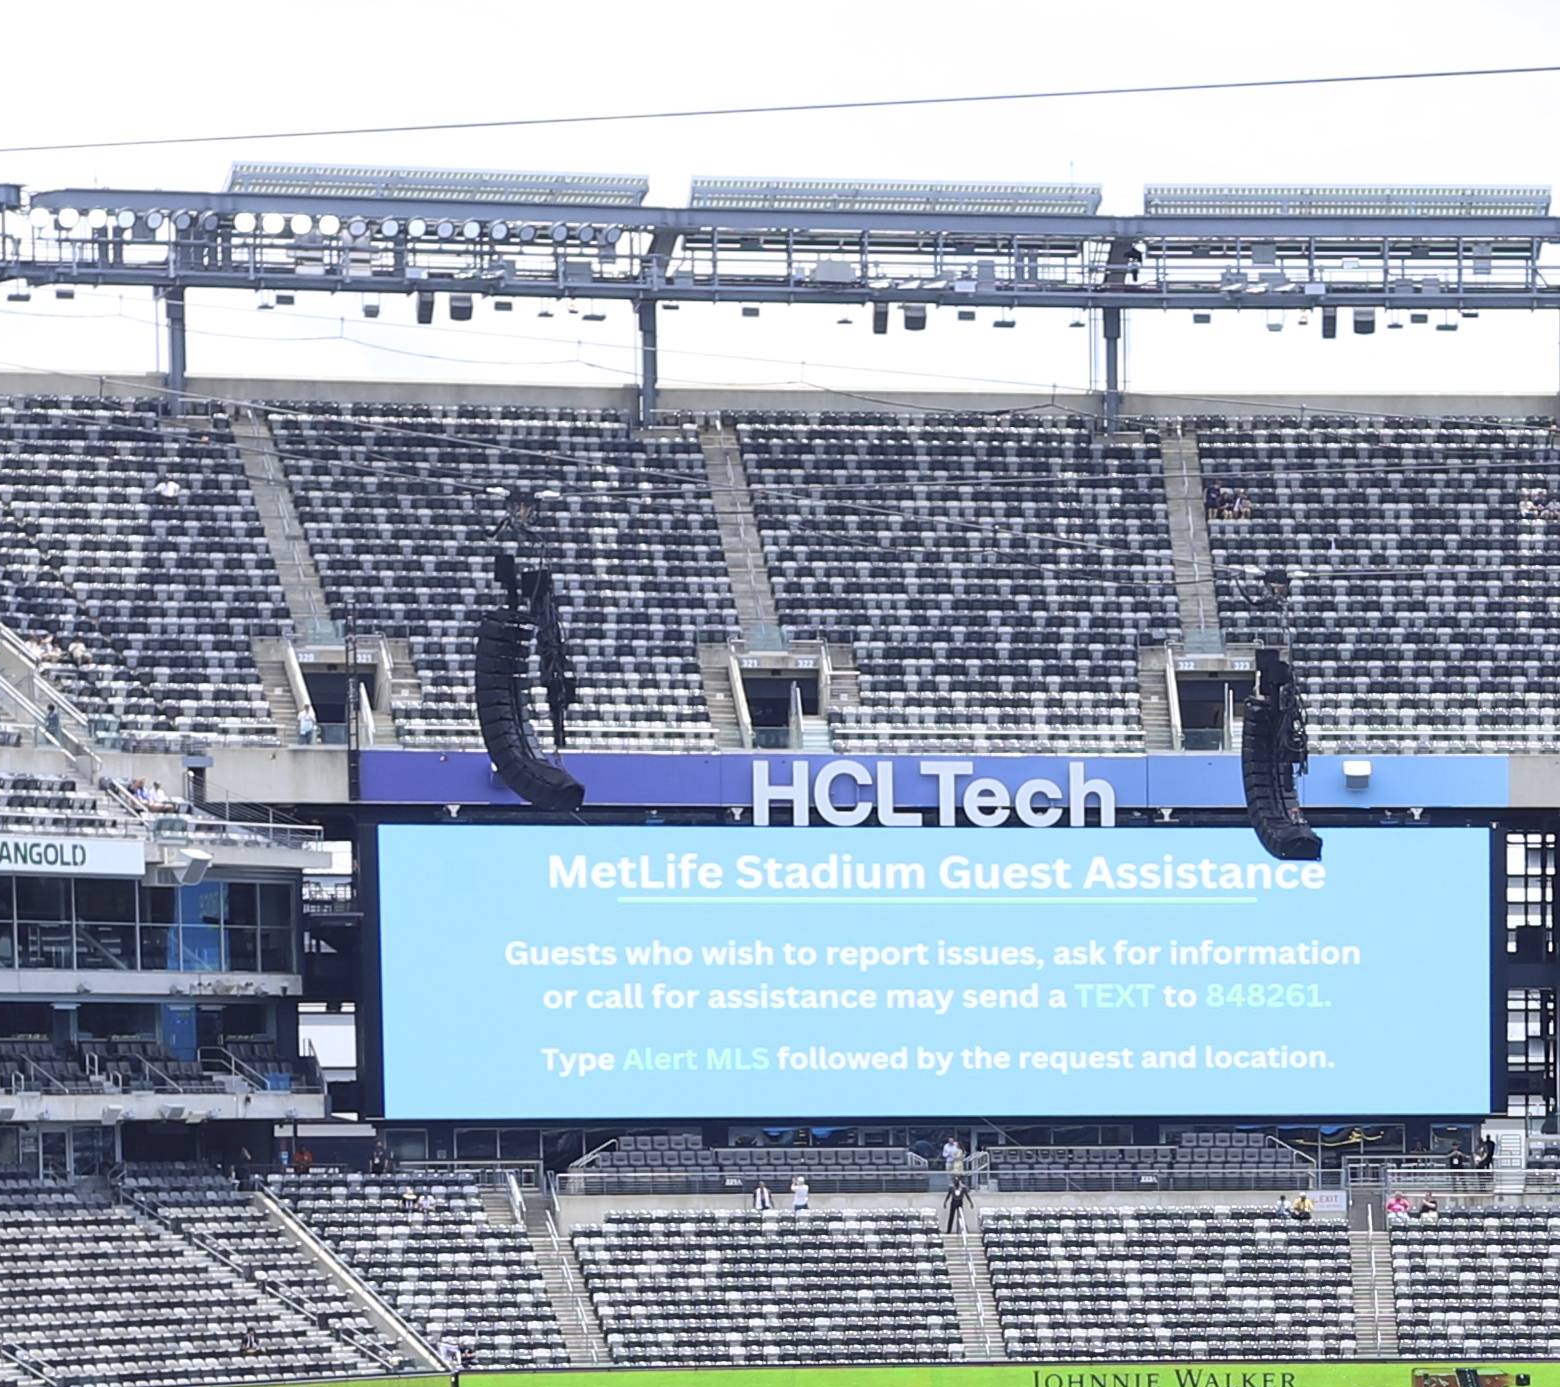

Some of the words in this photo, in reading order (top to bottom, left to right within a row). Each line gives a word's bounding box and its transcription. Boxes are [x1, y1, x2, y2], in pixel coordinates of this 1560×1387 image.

[742, 658, 758, 668] 321
[797, 659, 813, 668] 322
[1178, 661, 1194, 670] 322
[1233, 661, 1249, 670] 323
[752, 759, 1116, 827] HCLTech
[549, 853, 723, 888] MetLife
[736, 853, 925, 889] Stadium
[939, 855, 1072, 889] Guest
[1083, 854, 1326, 889] Assistance
[505, 941, 617, 966] Guests
[625, 940, 693, 965] who
[702, 940, 774, 965] wish
[783, 944, 817, 965] to
[826, 944, 929, 972] report
[938, 940, 1044, 969] issues,
[1053, 940, 1106, 965] ask
[1113, 939, 1161, 965] for
[1170, 939, 1360, 965] information
[543, 990, 578, 1009] or
[586, 983, 644, 1008] call
[651, 983, 700, 1008] for
[708, 983, 877, 1008] assistance
[887, 989, 954, 1014] may
[963, 983, 1040, 1008] send
[1048, 989, 1067, 1008] a
[1076, 984, 1154, 1007] TEXT
[1163, 986, 1197, 1008] to
[1207, 984, 1330, 1007] 848261.
[541, 1048, 615, 1077] Type
[625, 1047, 697, 1070] Alert
[708, 1048, 768, 1070] MLS
[777, 1046, 908, 1070] followed
[917, 1046, 953, 1076] by
[961, 1046, 1011, 1069] the
[1019, 1048, 1134, 1074] request
[1141, 1045, 1196, 1068] and
[1205, 1045, 1335, 1069] location.
